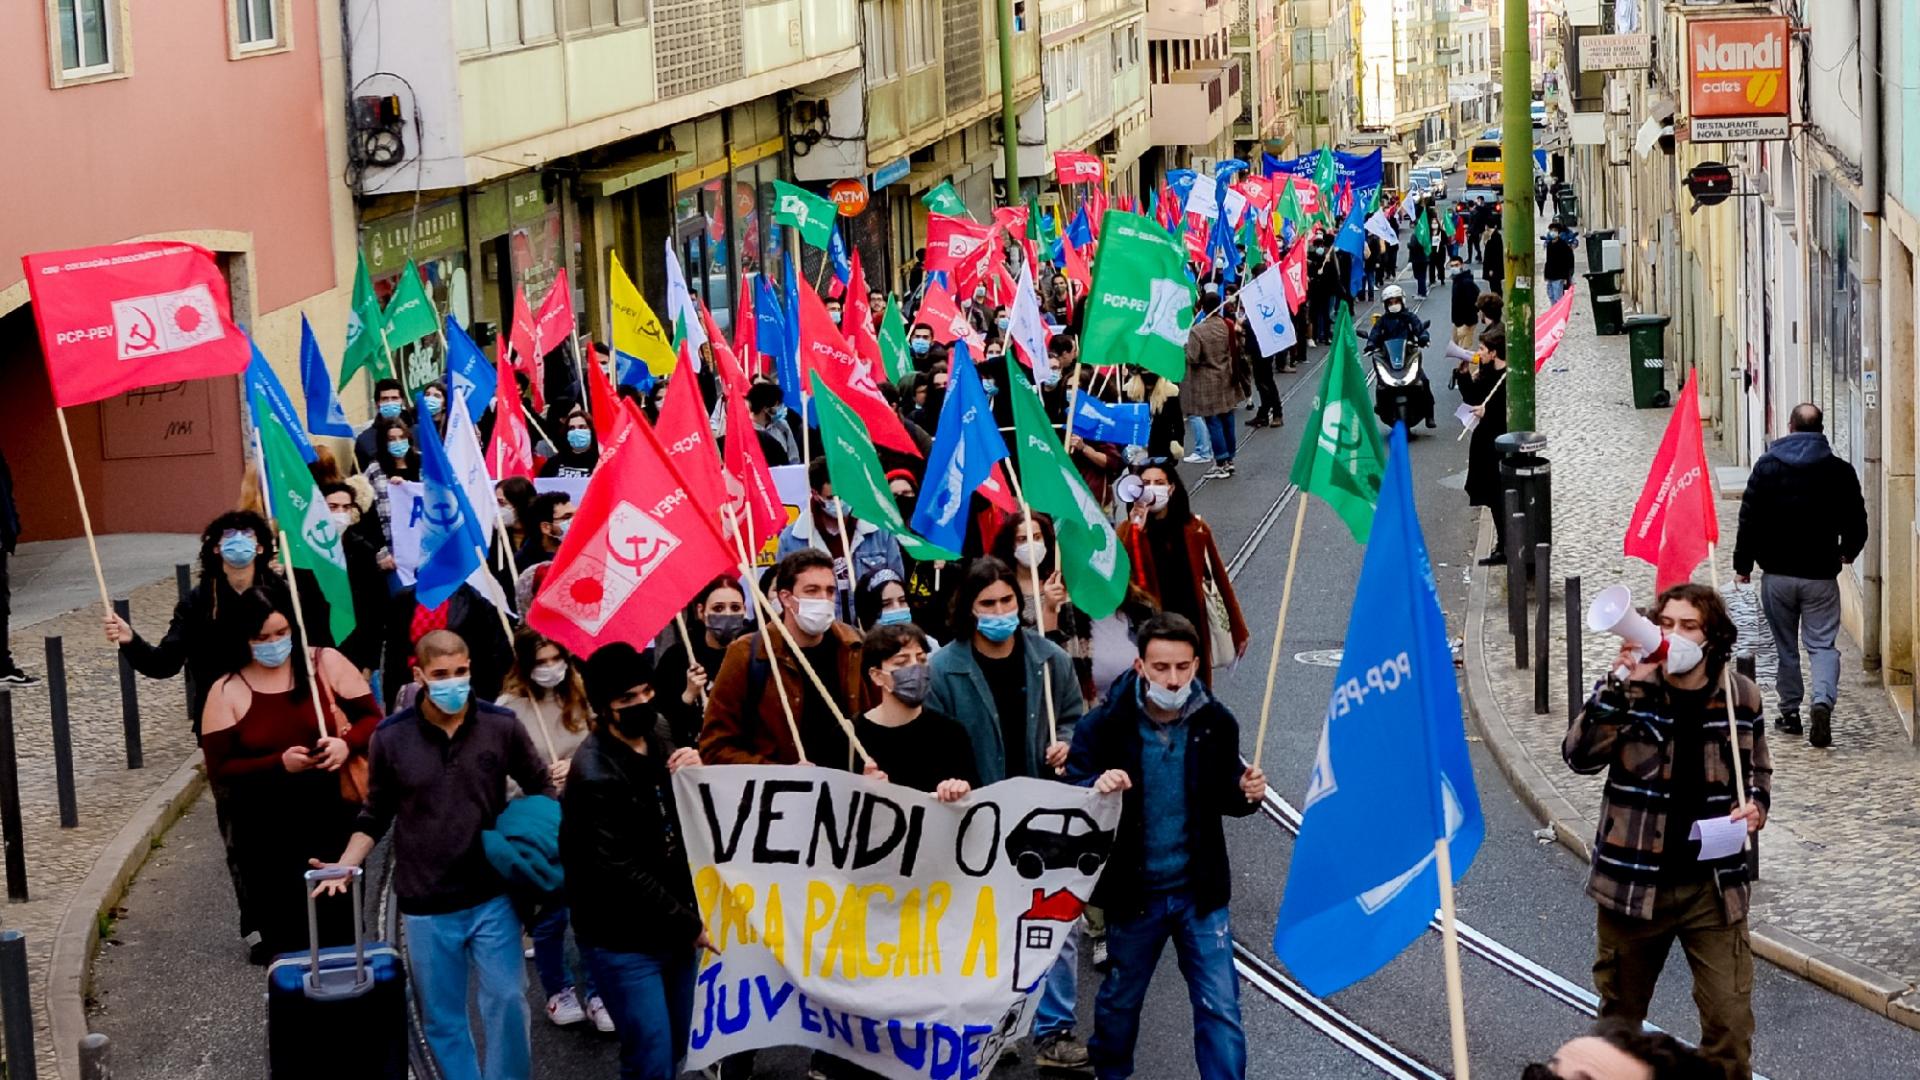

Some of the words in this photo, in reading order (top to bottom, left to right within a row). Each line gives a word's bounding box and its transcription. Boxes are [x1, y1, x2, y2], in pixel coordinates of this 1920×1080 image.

[1696, 32, 1782, 71] Nandi
[1696, 120, 1759, 130] RESTAURANTE
[1728, 128, 1786, 138] ESPERANÇA
[834, 190, 864, 203] ATM
[57, 325, 113, 345] PCP-PEV
[812, 341, 855, 366] PCP-PEV
[698, 780, 925, 877] VENDI
[956, 801, 1000, 877] O
[694, 864, 785, 968] PARA
[802, 880, 951, 979] PAGAR
[960, 885, 998, 979] A
[691, 961, 993, 1080] JUVENTUDE
